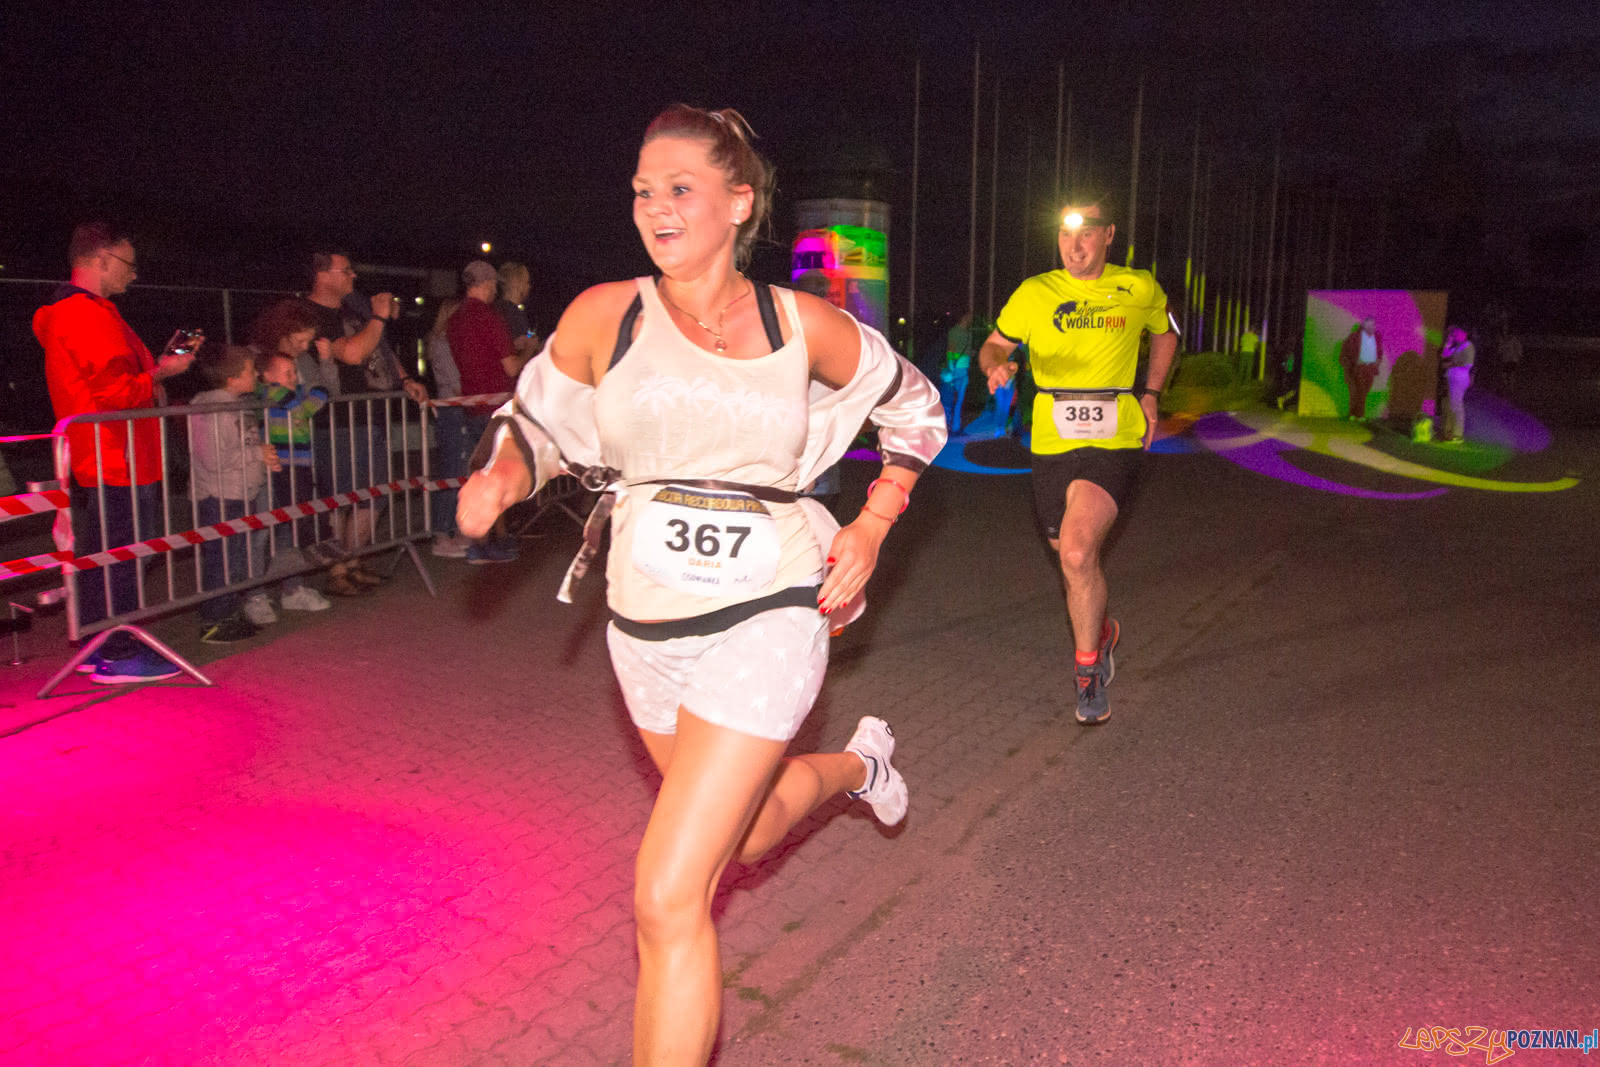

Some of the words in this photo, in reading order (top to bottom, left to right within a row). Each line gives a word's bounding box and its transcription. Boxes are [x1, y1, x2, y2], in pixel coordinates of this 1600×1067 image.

[1065, 406, 1104, 422] 383
[665, 518, 752, 558] 367
[688, 558, 721, 568] DARIA
